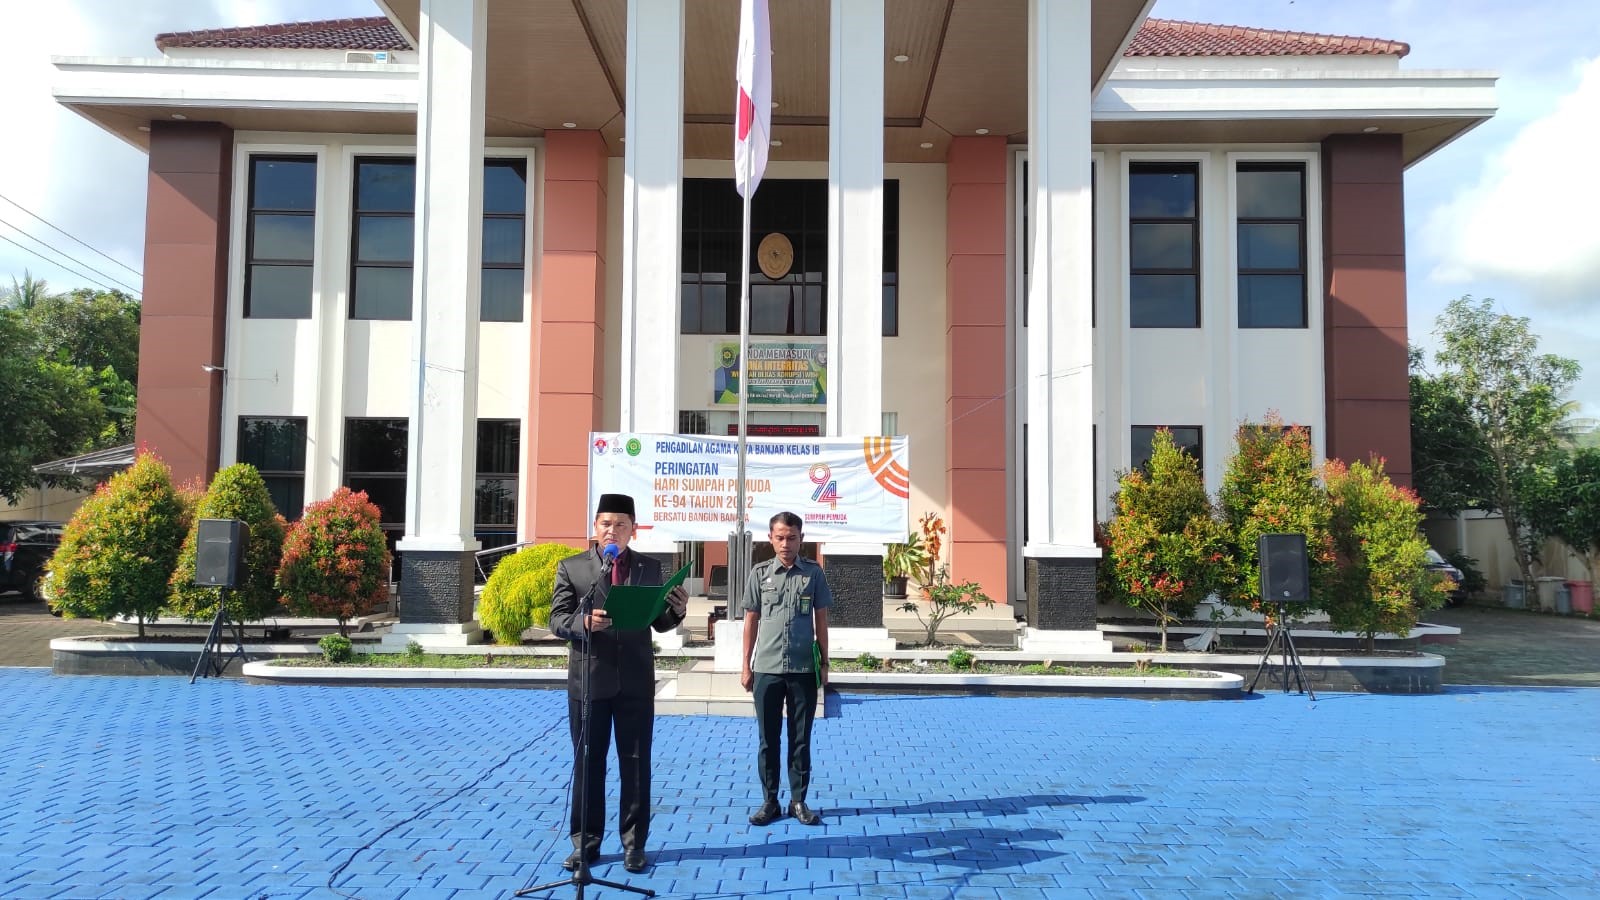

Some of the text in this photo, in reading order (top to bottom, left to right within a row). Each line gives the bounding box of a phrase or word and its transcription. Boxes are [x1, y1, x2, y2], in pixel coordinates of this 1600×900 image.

[747, 349, 813, 359] NDA MEMASUKI
[765, 360, 809, 371] INTEGRITAS
[656, 441, 703, 454] PENGADILAN
[705, 442, 731, 454] AGAMA
[733, 443, 753, 454] KTA
[755, 444, 784, 455] BANJAR
[786, 444, 811, 455] KELAS
[655, 461, 719, 476] PERINGATAN
[654, 478, 679, 491] HARI
[681, 478, 725, 492] SUMPAH
[654, 495, 754, 509] KE-94 TAHUN 202
[653, 511, 749, 522] BERSATU BANGUN BANA
[804, 513, 848, 521] SUMPAH PEMUDA
